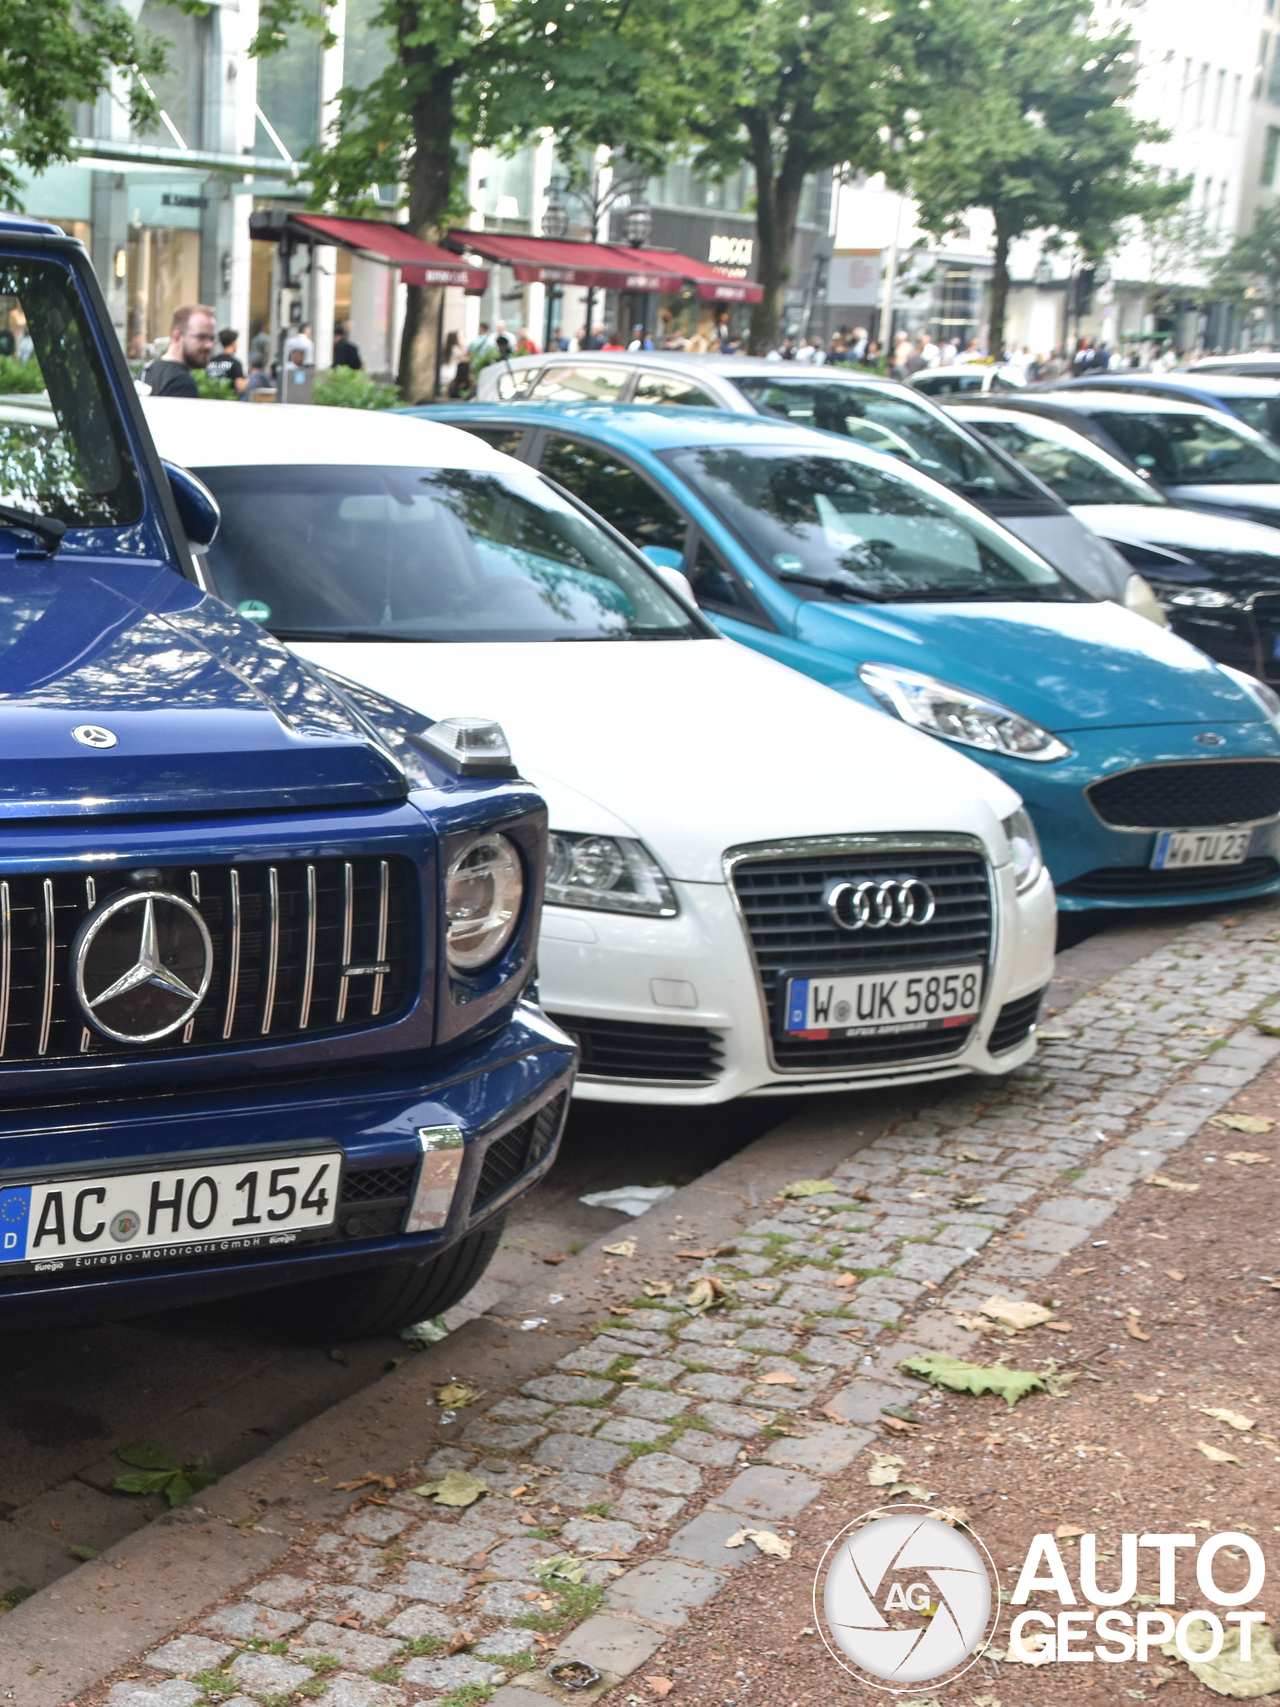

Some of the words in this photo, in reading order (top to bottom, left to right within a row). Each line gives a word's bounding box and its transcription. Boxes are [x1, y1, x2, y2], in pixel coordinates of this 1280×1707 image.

[1193, 835, 1222, 862] TU
[1220, 834, 1248, 860] 23
[813, 985, 833, 1023] W
[857, 980, 898, 1020] UK
[905, 973, 977, 1015] 5858
[4, 1233, 17, 1249] D
[33, 1186, 106, 1248] AC
[148, 1175, 219, 1236] HO
[232, 1163, 329, 1227] 154
[220, 1237, 261, 1250] GmbH
